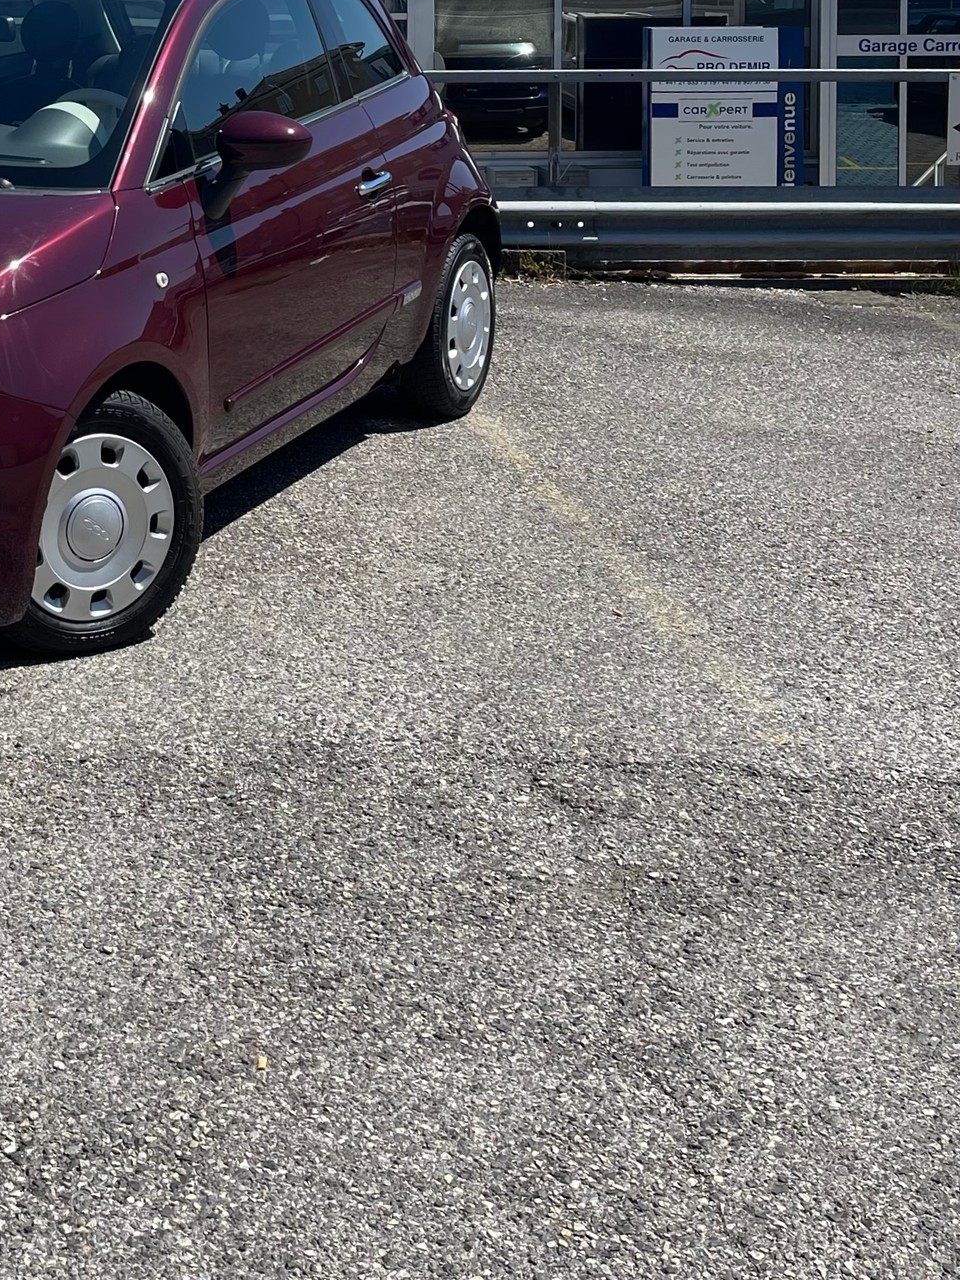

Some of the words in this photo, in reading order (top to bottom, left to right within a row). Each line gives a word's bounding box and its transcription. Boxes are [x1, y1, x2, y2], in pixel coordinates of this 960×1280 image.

[668, 35, 702, 43] GARAGE
[704, 35, 709, 43] &
[711, 35, 765, 43] CARROSSERIE
[858, 38, 918, 55] Garage
[923, 38, 960, 52] Carr
